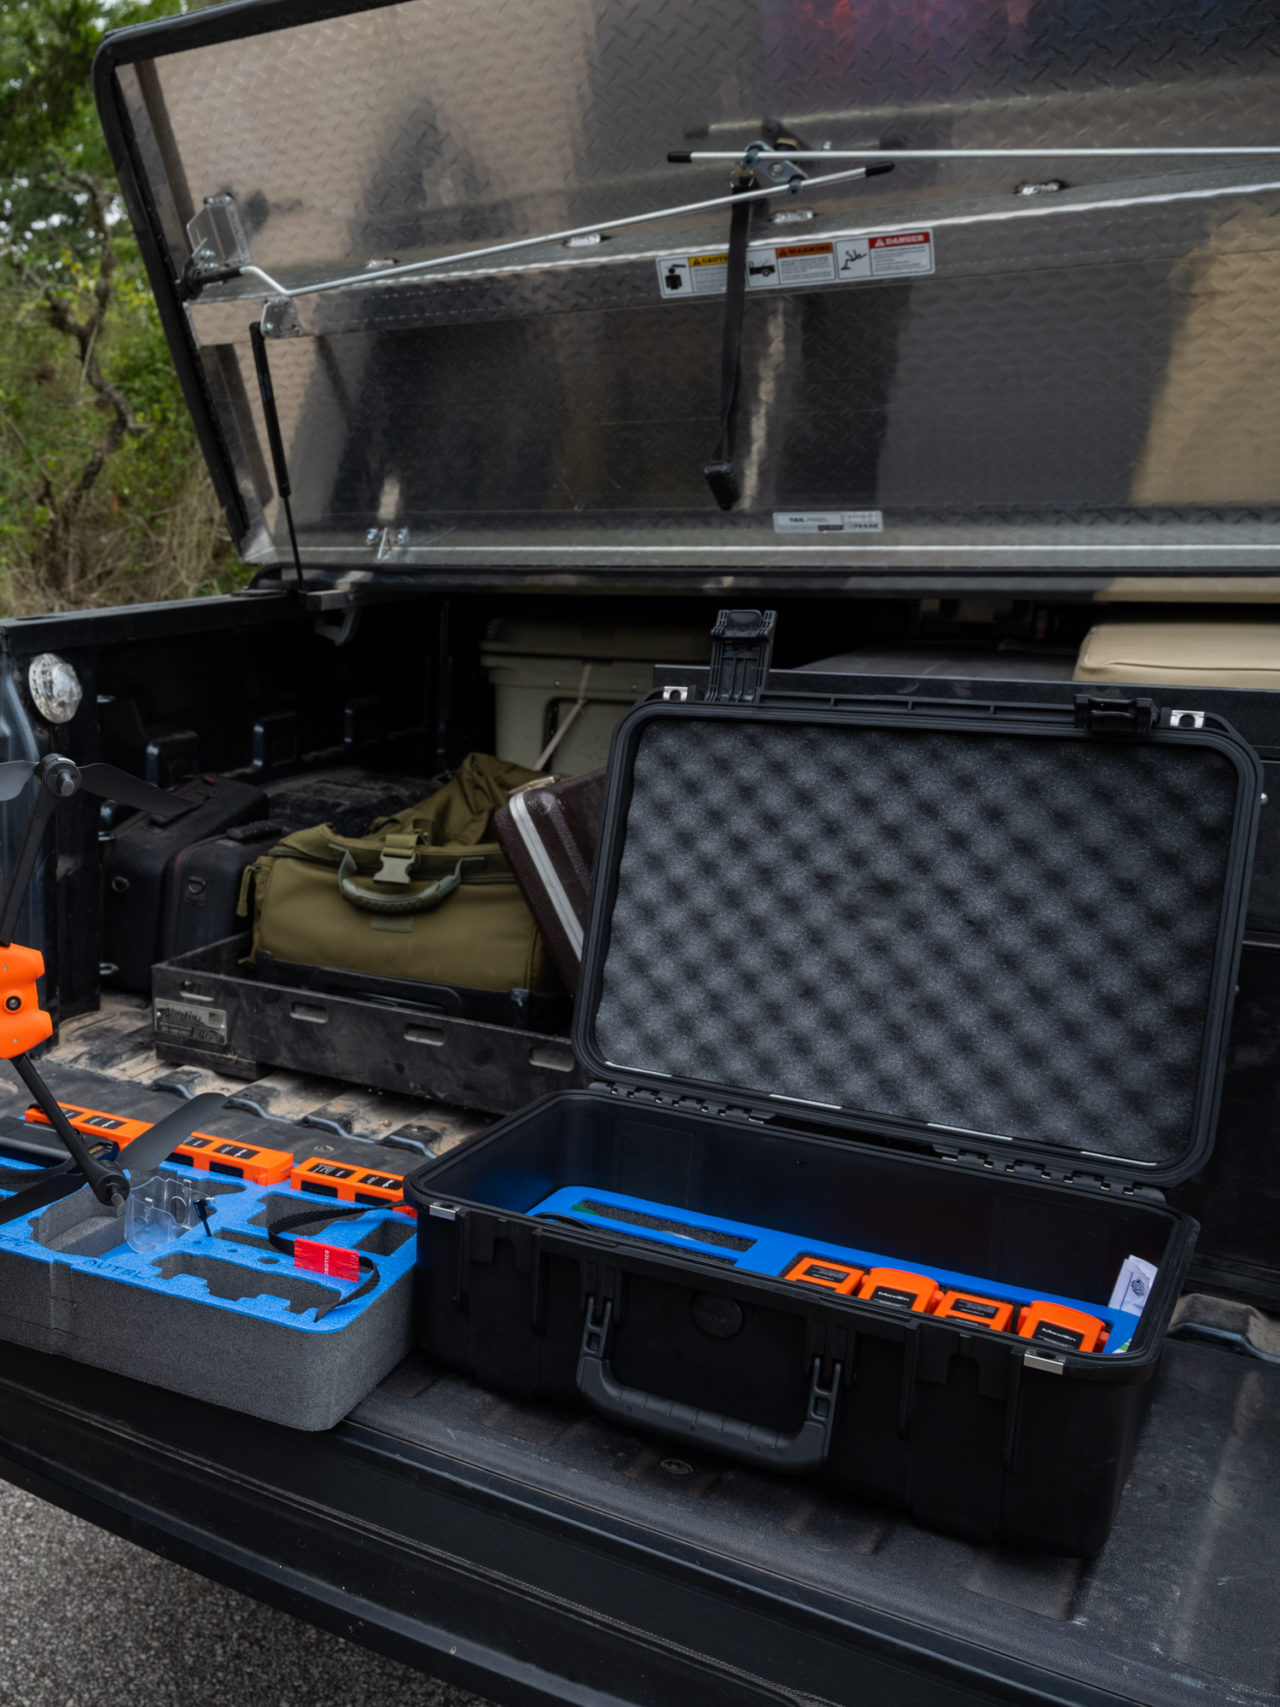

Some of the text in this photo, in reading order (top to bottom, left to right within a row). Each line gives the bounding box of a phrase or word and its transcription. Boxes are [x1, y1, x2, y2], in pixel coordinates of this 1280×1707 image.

[885, 234, 924, 245] DANGER
[788, 245, 831, 254] WARNING
[702, 255, 728, 264] CAUTI
[82, 1259, 143, 1279] AUTEL
